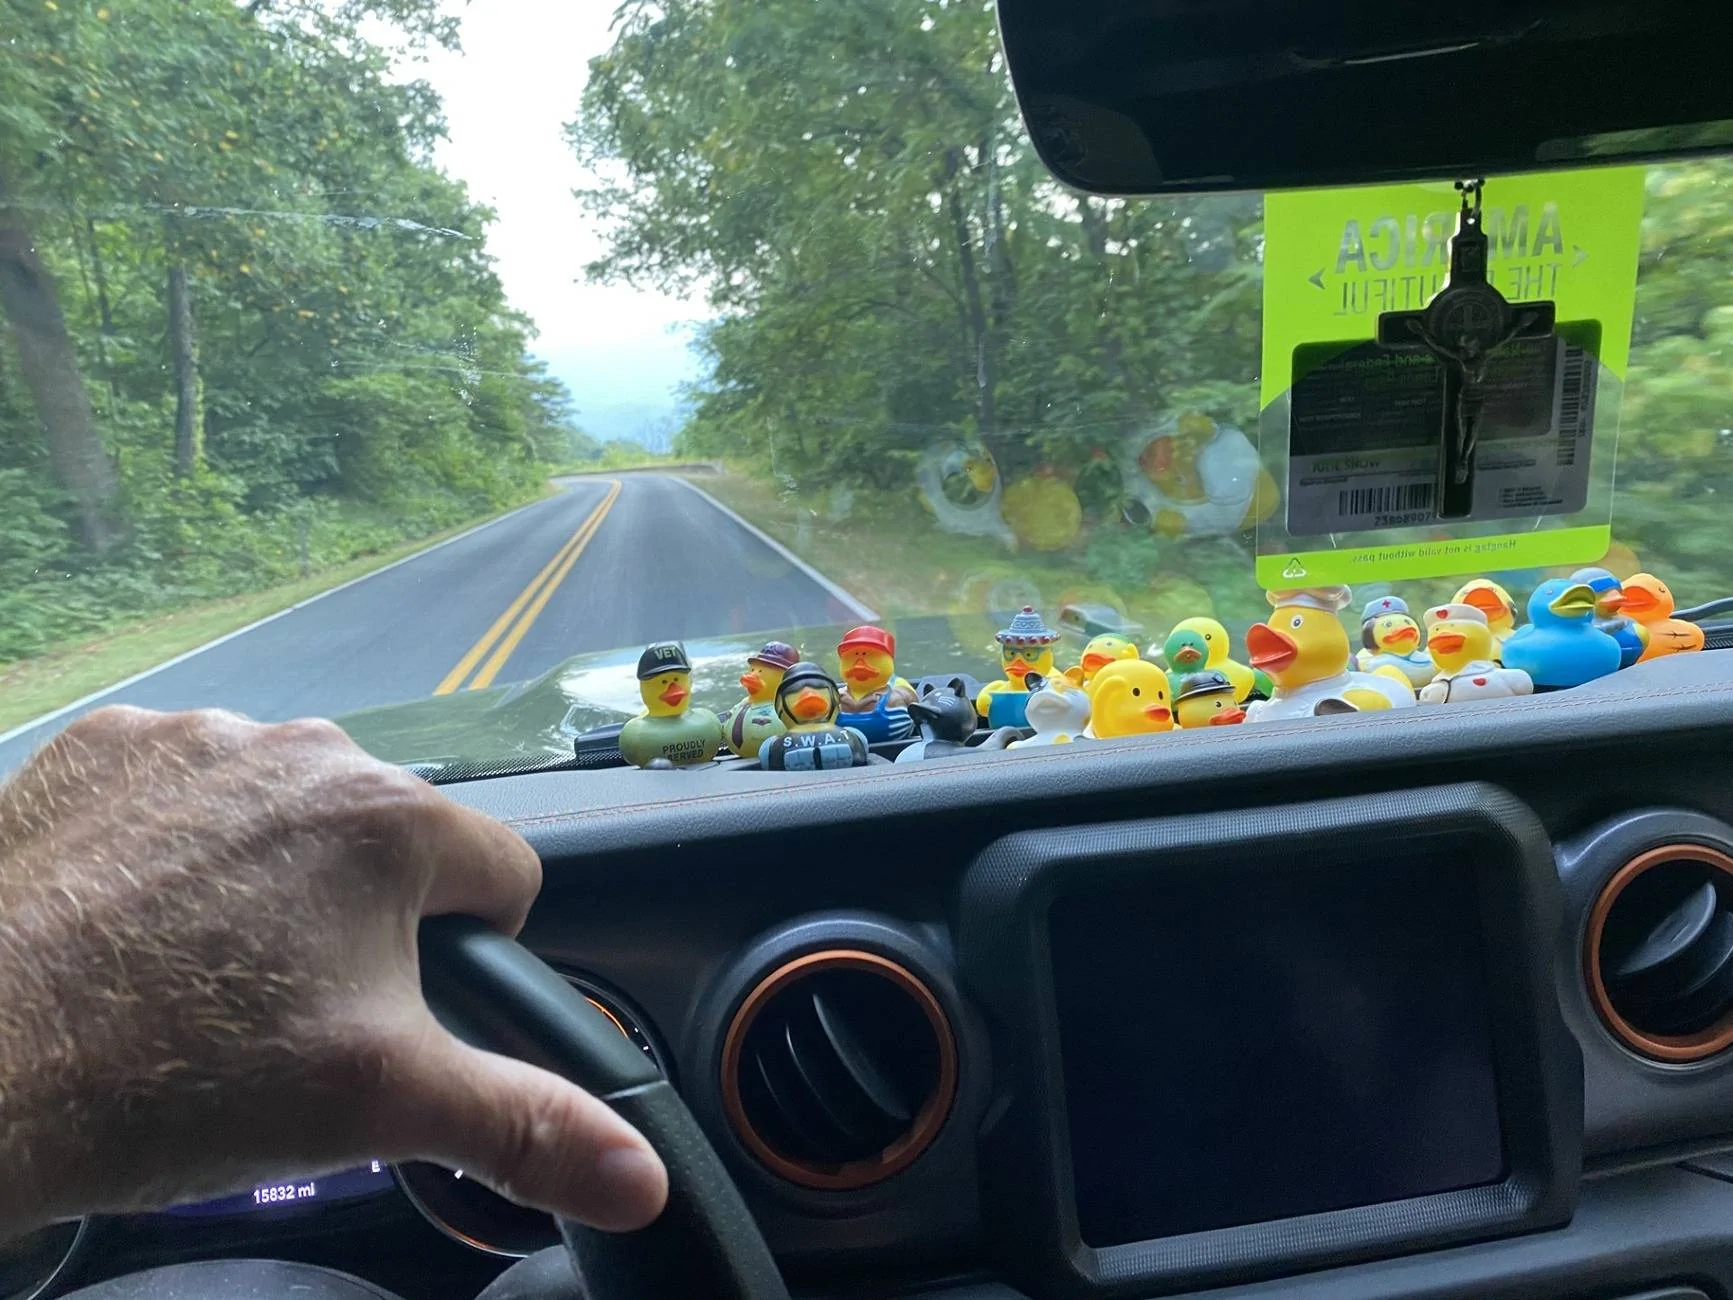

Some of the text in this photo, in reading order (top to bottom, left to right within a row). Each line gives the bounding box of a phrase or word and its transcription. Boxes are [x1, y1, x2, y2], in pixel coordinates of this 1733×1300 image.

[654, 646, 677, 660] VET
[662, 738, 706, 754] PROUDLY
[667, 748, 704, 761] SERVED
[253, 1182, 316, 1204] 15832 mi
